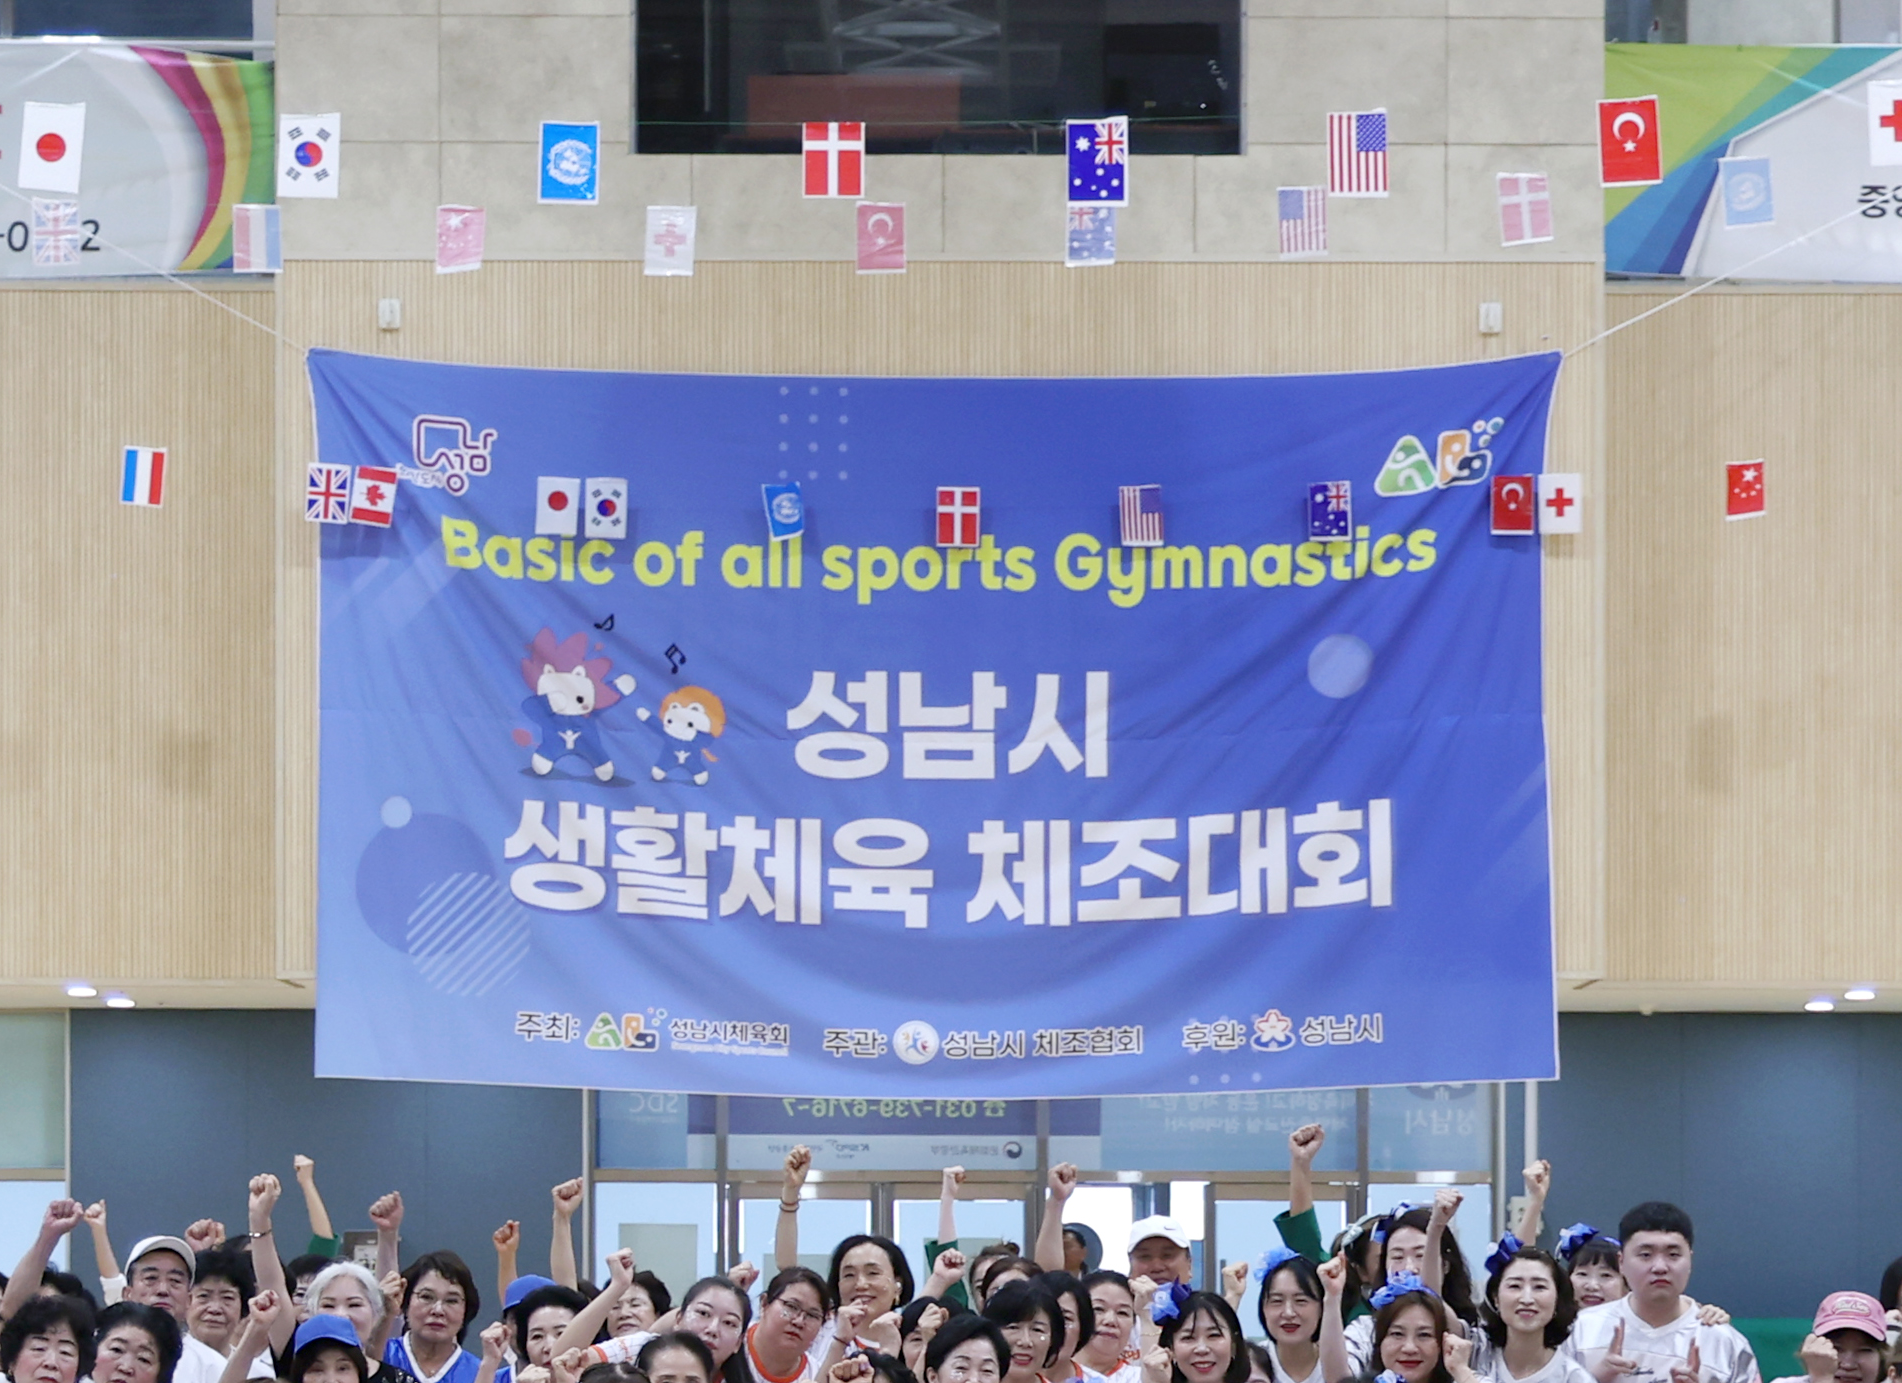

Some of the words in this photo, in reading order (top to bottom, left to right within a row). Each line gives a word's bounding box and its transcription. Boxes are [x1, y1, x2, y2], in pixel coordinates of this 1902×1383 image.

[441, 515, 616, 586] Basic
[633, 530, 704, 587] of
[722, 536, 802, 588] all
[822, 534, 1036, 604] sports
[1054, 525, 1438, 608] Gymnastics
[786, 670, 1110, 780] 성남시
[503, 799, 935, 929] 생활체육
[965, 798, 1394, 927] 체조대회
[517, 1012, 580, 1041] 주최:
[669, 1018, 789, 1045] 성남시체육회
[824, 1030, 885, 1056] 주관:
[942, 1031, 1024, 1057] 성남시
[1034, 1027, 1142, 1054] 체조협회
[1183, 1023, 1244, 1049] 후원:
[1301, 1015, 1383, 1046] 성남시
